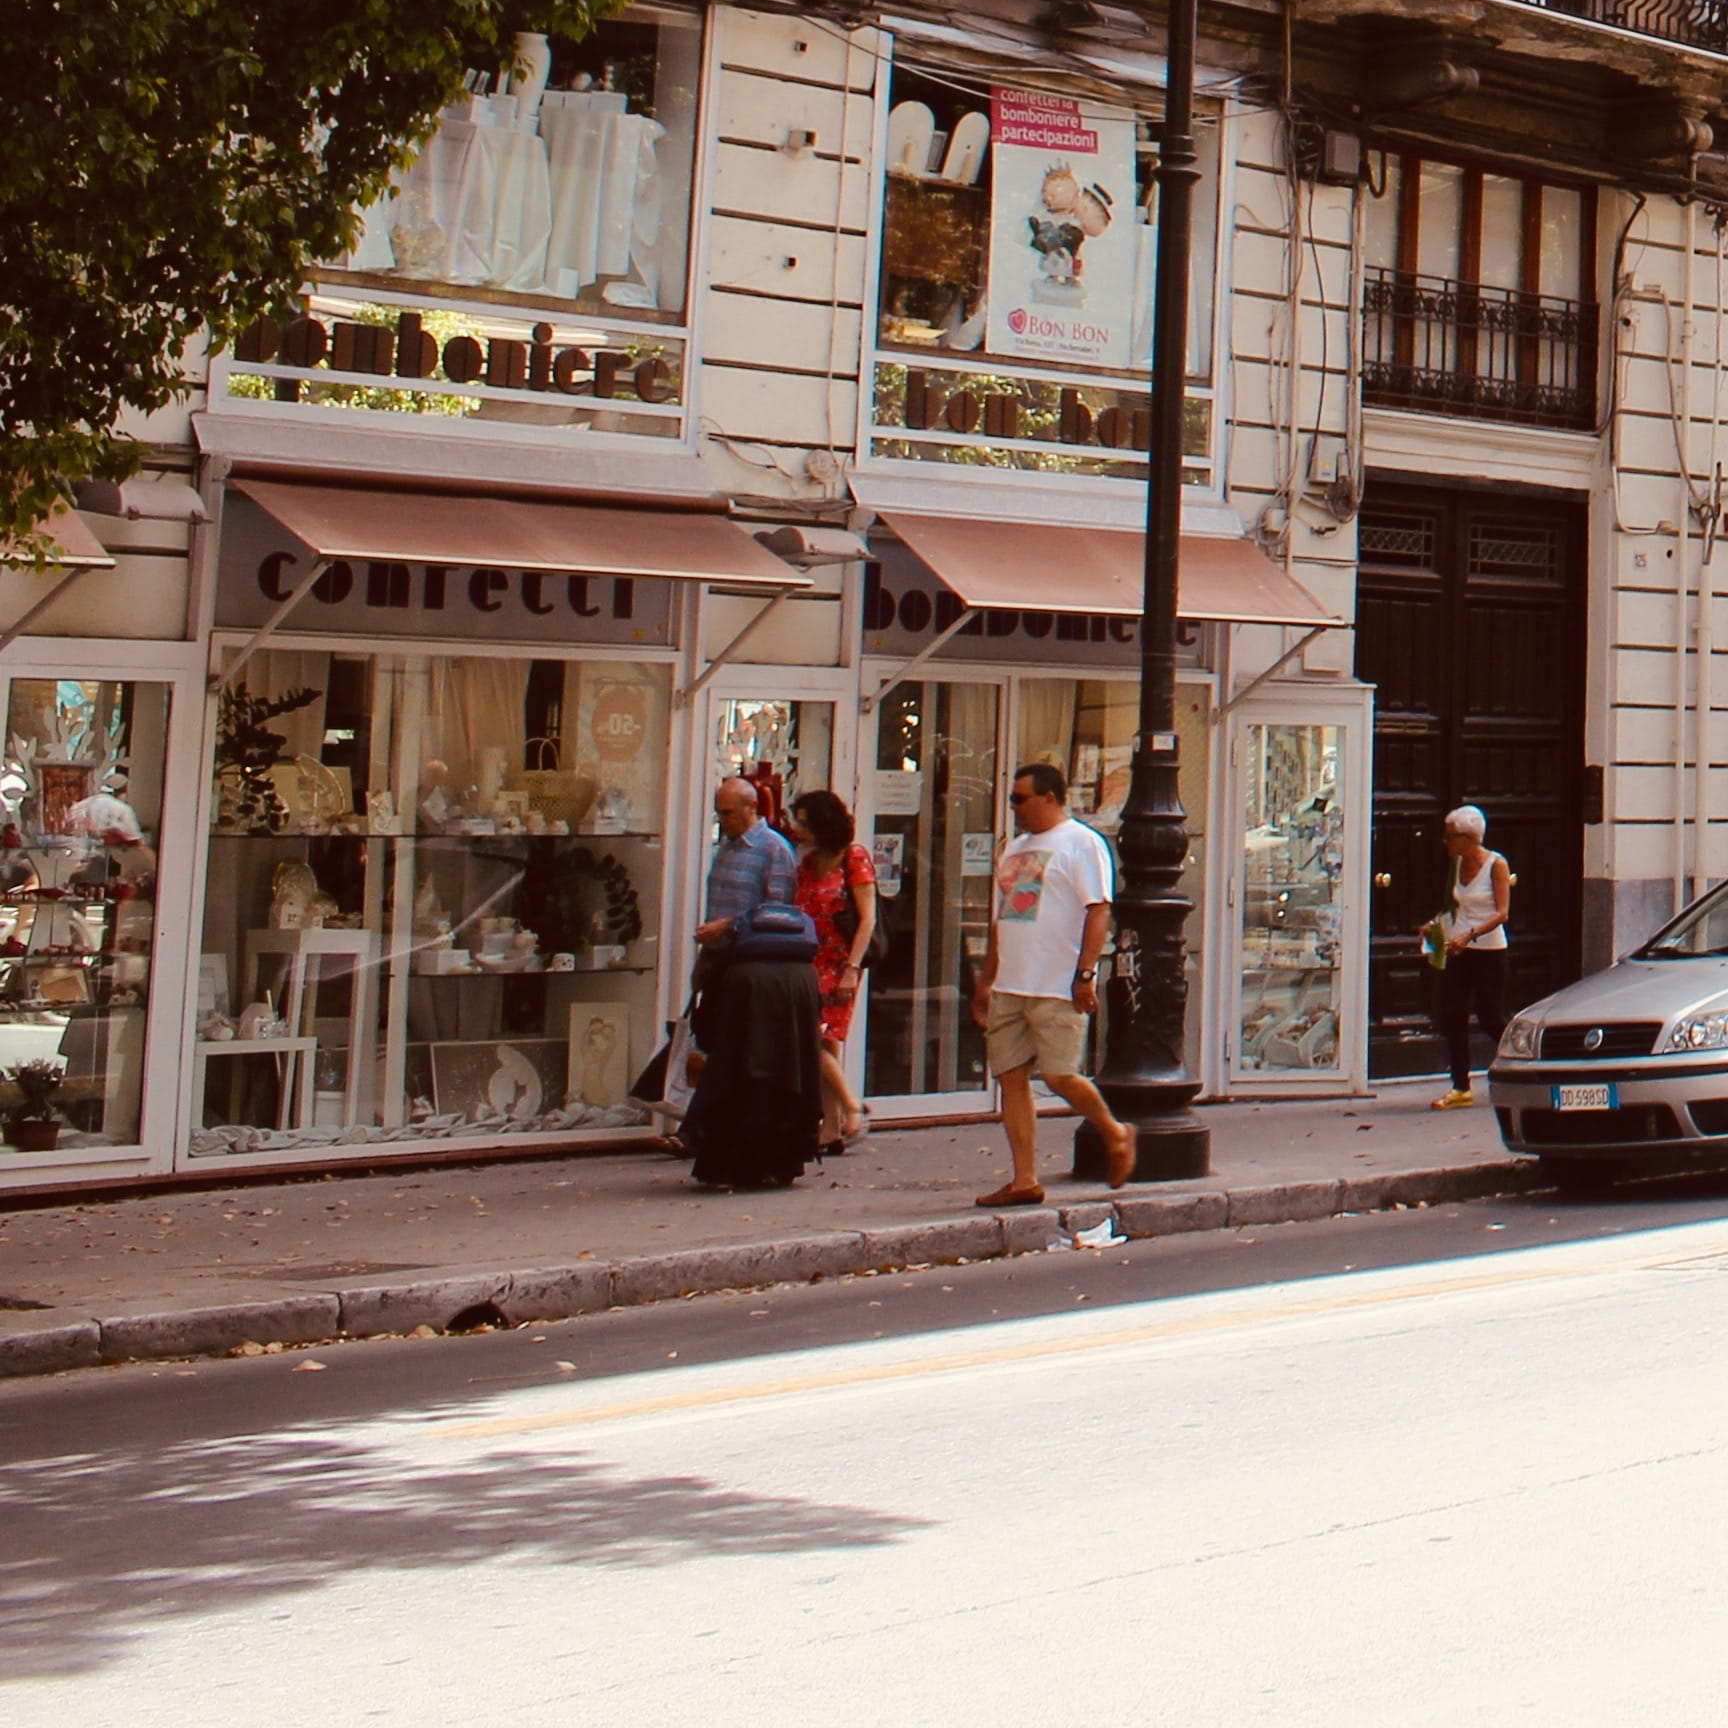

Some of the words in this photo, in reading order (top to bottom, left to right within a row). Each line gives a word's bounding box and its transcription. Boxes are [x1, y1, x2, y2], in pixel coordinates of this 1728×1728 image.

[1001, 105, 1079, 128] bomboniere
[1001, 126, 1096, 148] partecipazioni
[1028, 315, 1066, 337] BON
[1072, 322, 1109, 344] BON
[906, 370, 1018, 439] bon
[863, 561, 1200, 647] bomoniee
